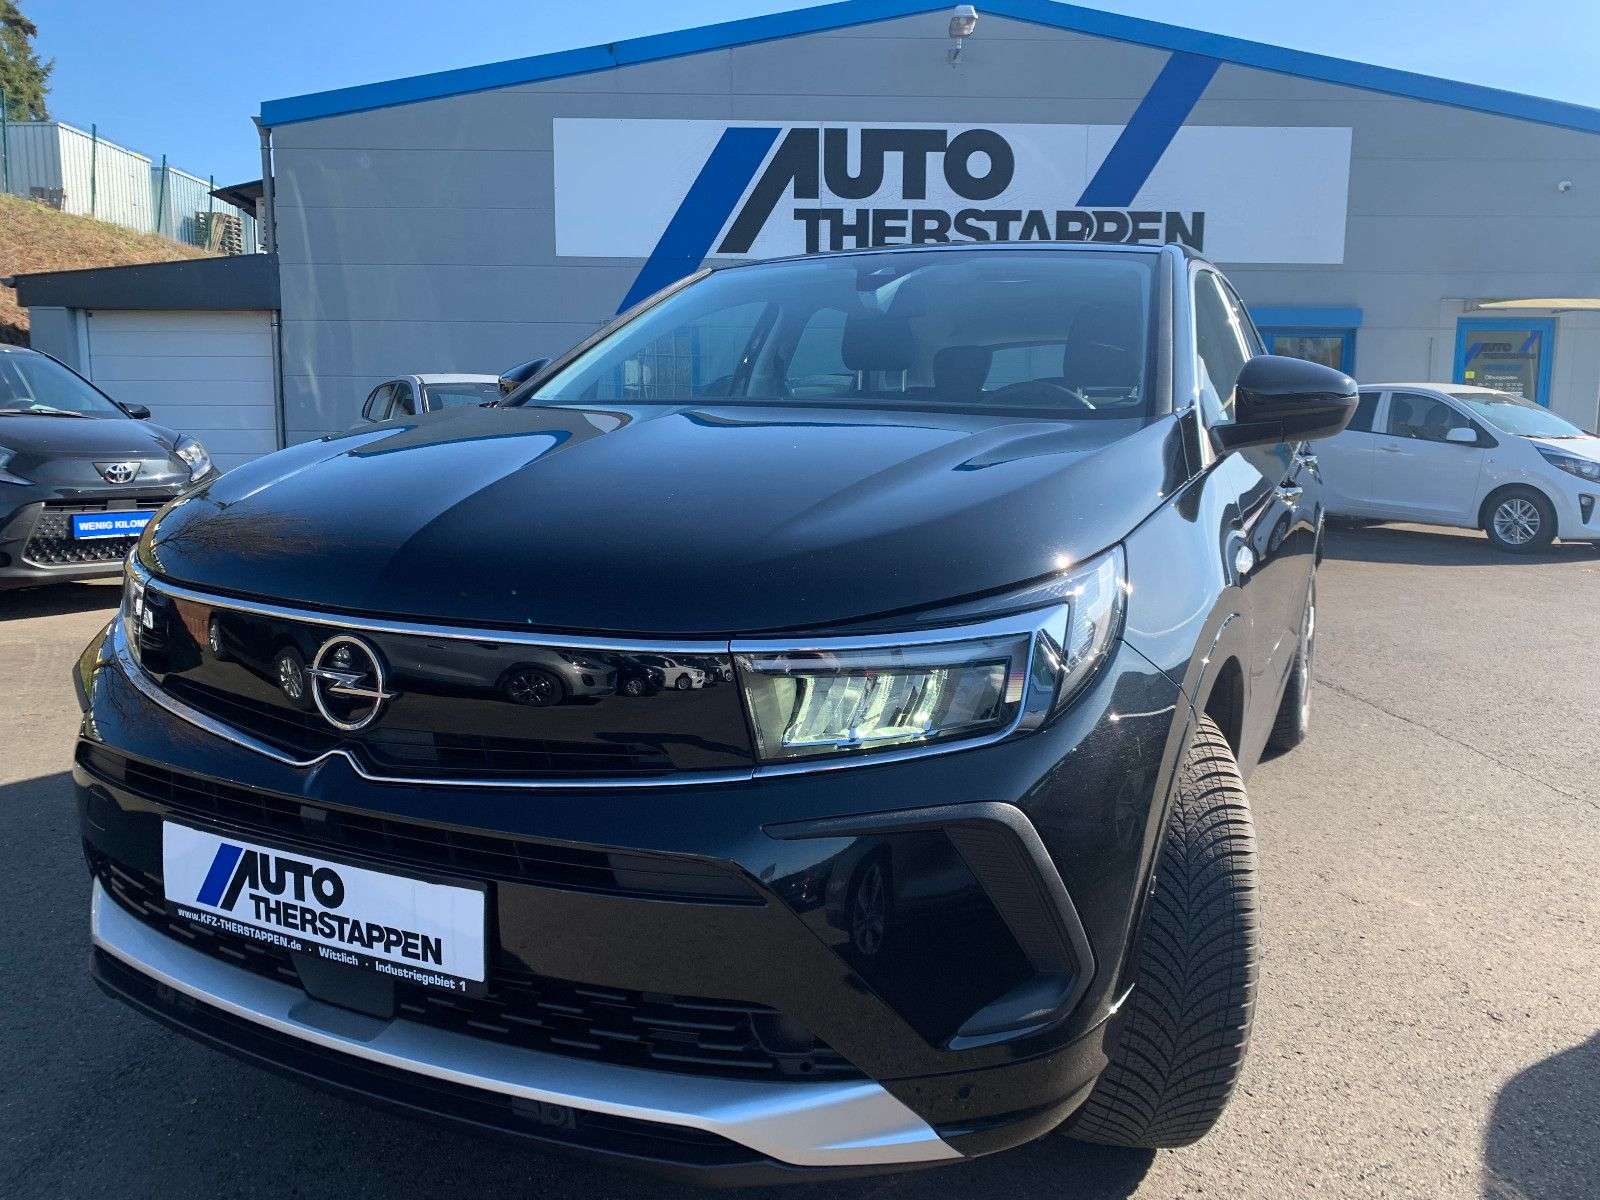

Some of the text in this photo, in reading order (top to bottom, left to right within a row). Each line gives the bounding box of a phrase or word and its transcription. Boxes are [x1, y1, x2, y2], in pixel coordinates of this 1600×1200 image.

[721, 128, 1015, 253] AUTO
[793, 208, 1205, 253] THERSTAPPEN
[79, 520, 113, 531] WENIG
[219, 849, 345, 912] AUTO
[177, 908, 466, 992] www.KFZ-THERSTAPPEN.de Wittlich Industriegebiet 1
[249, 893, 443, 966] THERSTAPPEN
